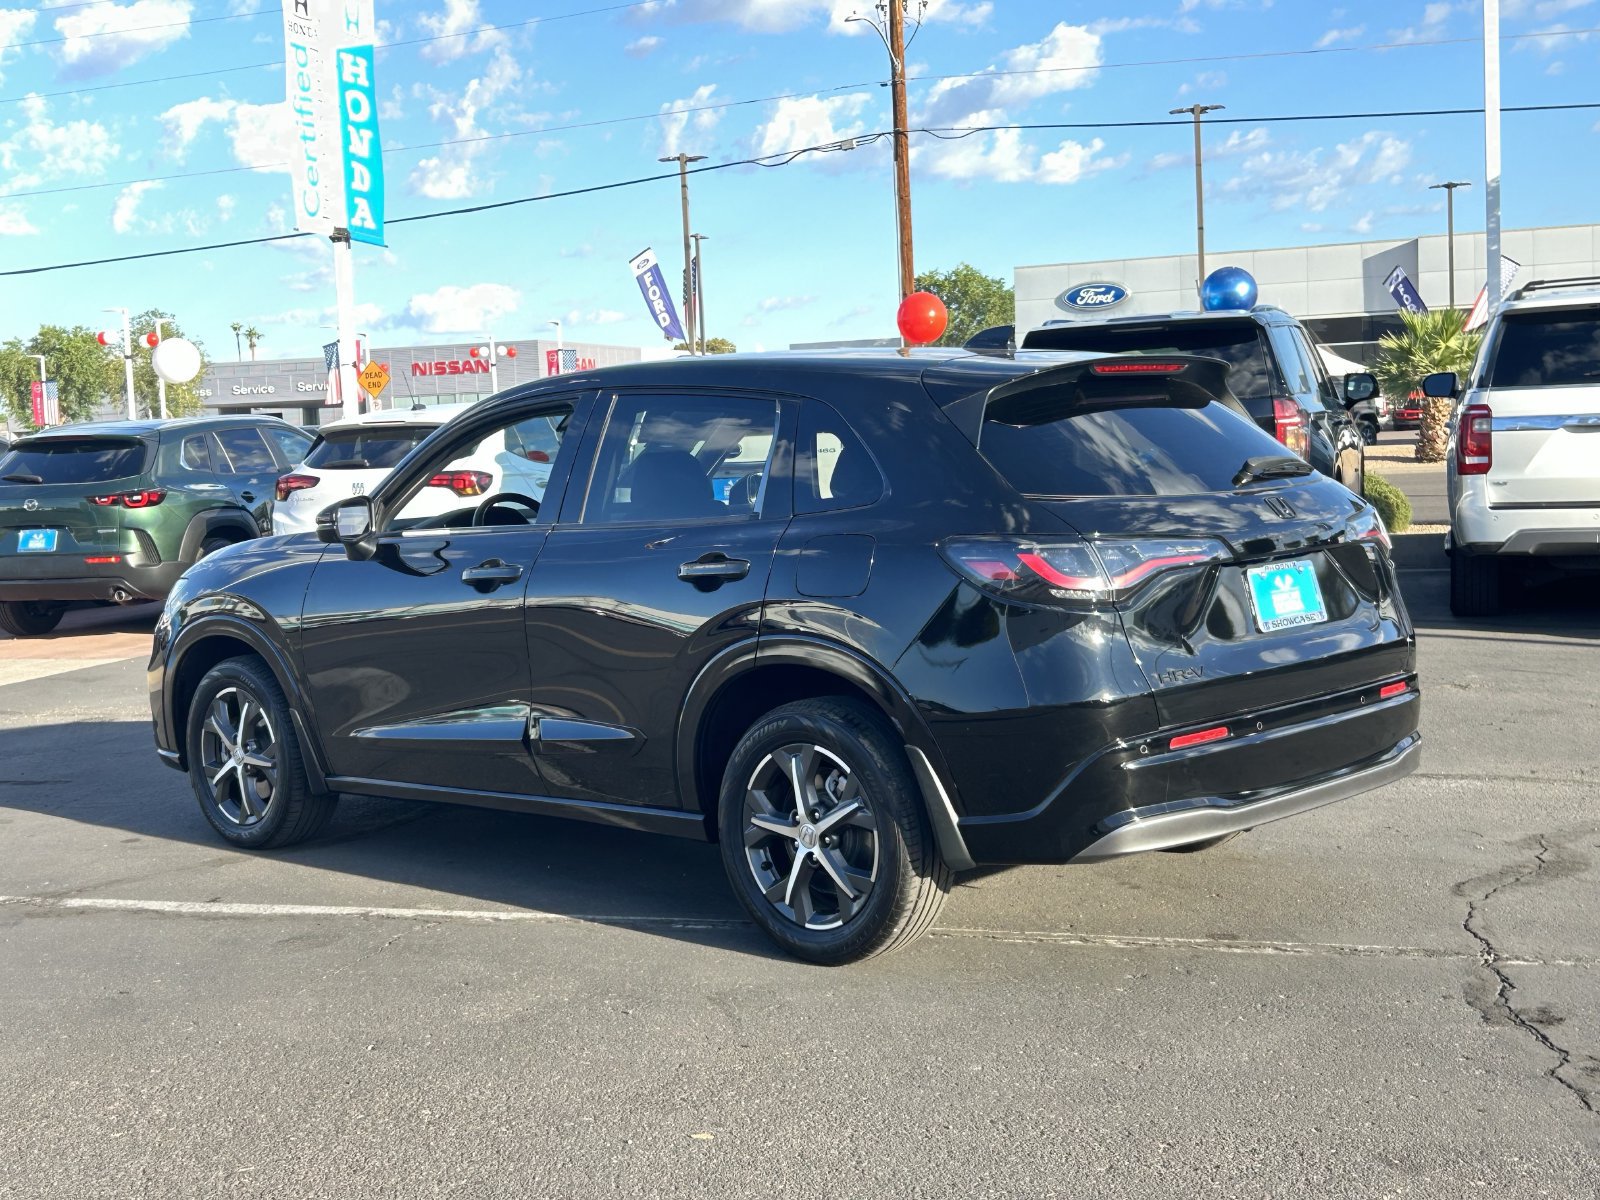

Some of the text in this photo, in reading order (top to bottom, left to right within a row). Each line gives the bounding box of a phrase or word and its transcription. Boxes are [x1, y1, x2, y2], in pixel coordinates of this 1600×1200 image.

[290, 42, 320, 217] Certified
[339, 51, 377, 230] HONDA
[643, 271, 671, 328] FORD
[1076, 287, 1116, 305] Ford
[1397, 283, 1418, 314] FOR
[365, 371, 383, 379] DEAD
[411, 359, 490, 377] NISSAN
[232, 384, 275, 395] Service
[297, 381, 330, 392] Servi
[367, 381, 382, 389] END
[1271, 613, 1317, 629] SHOWCASE
